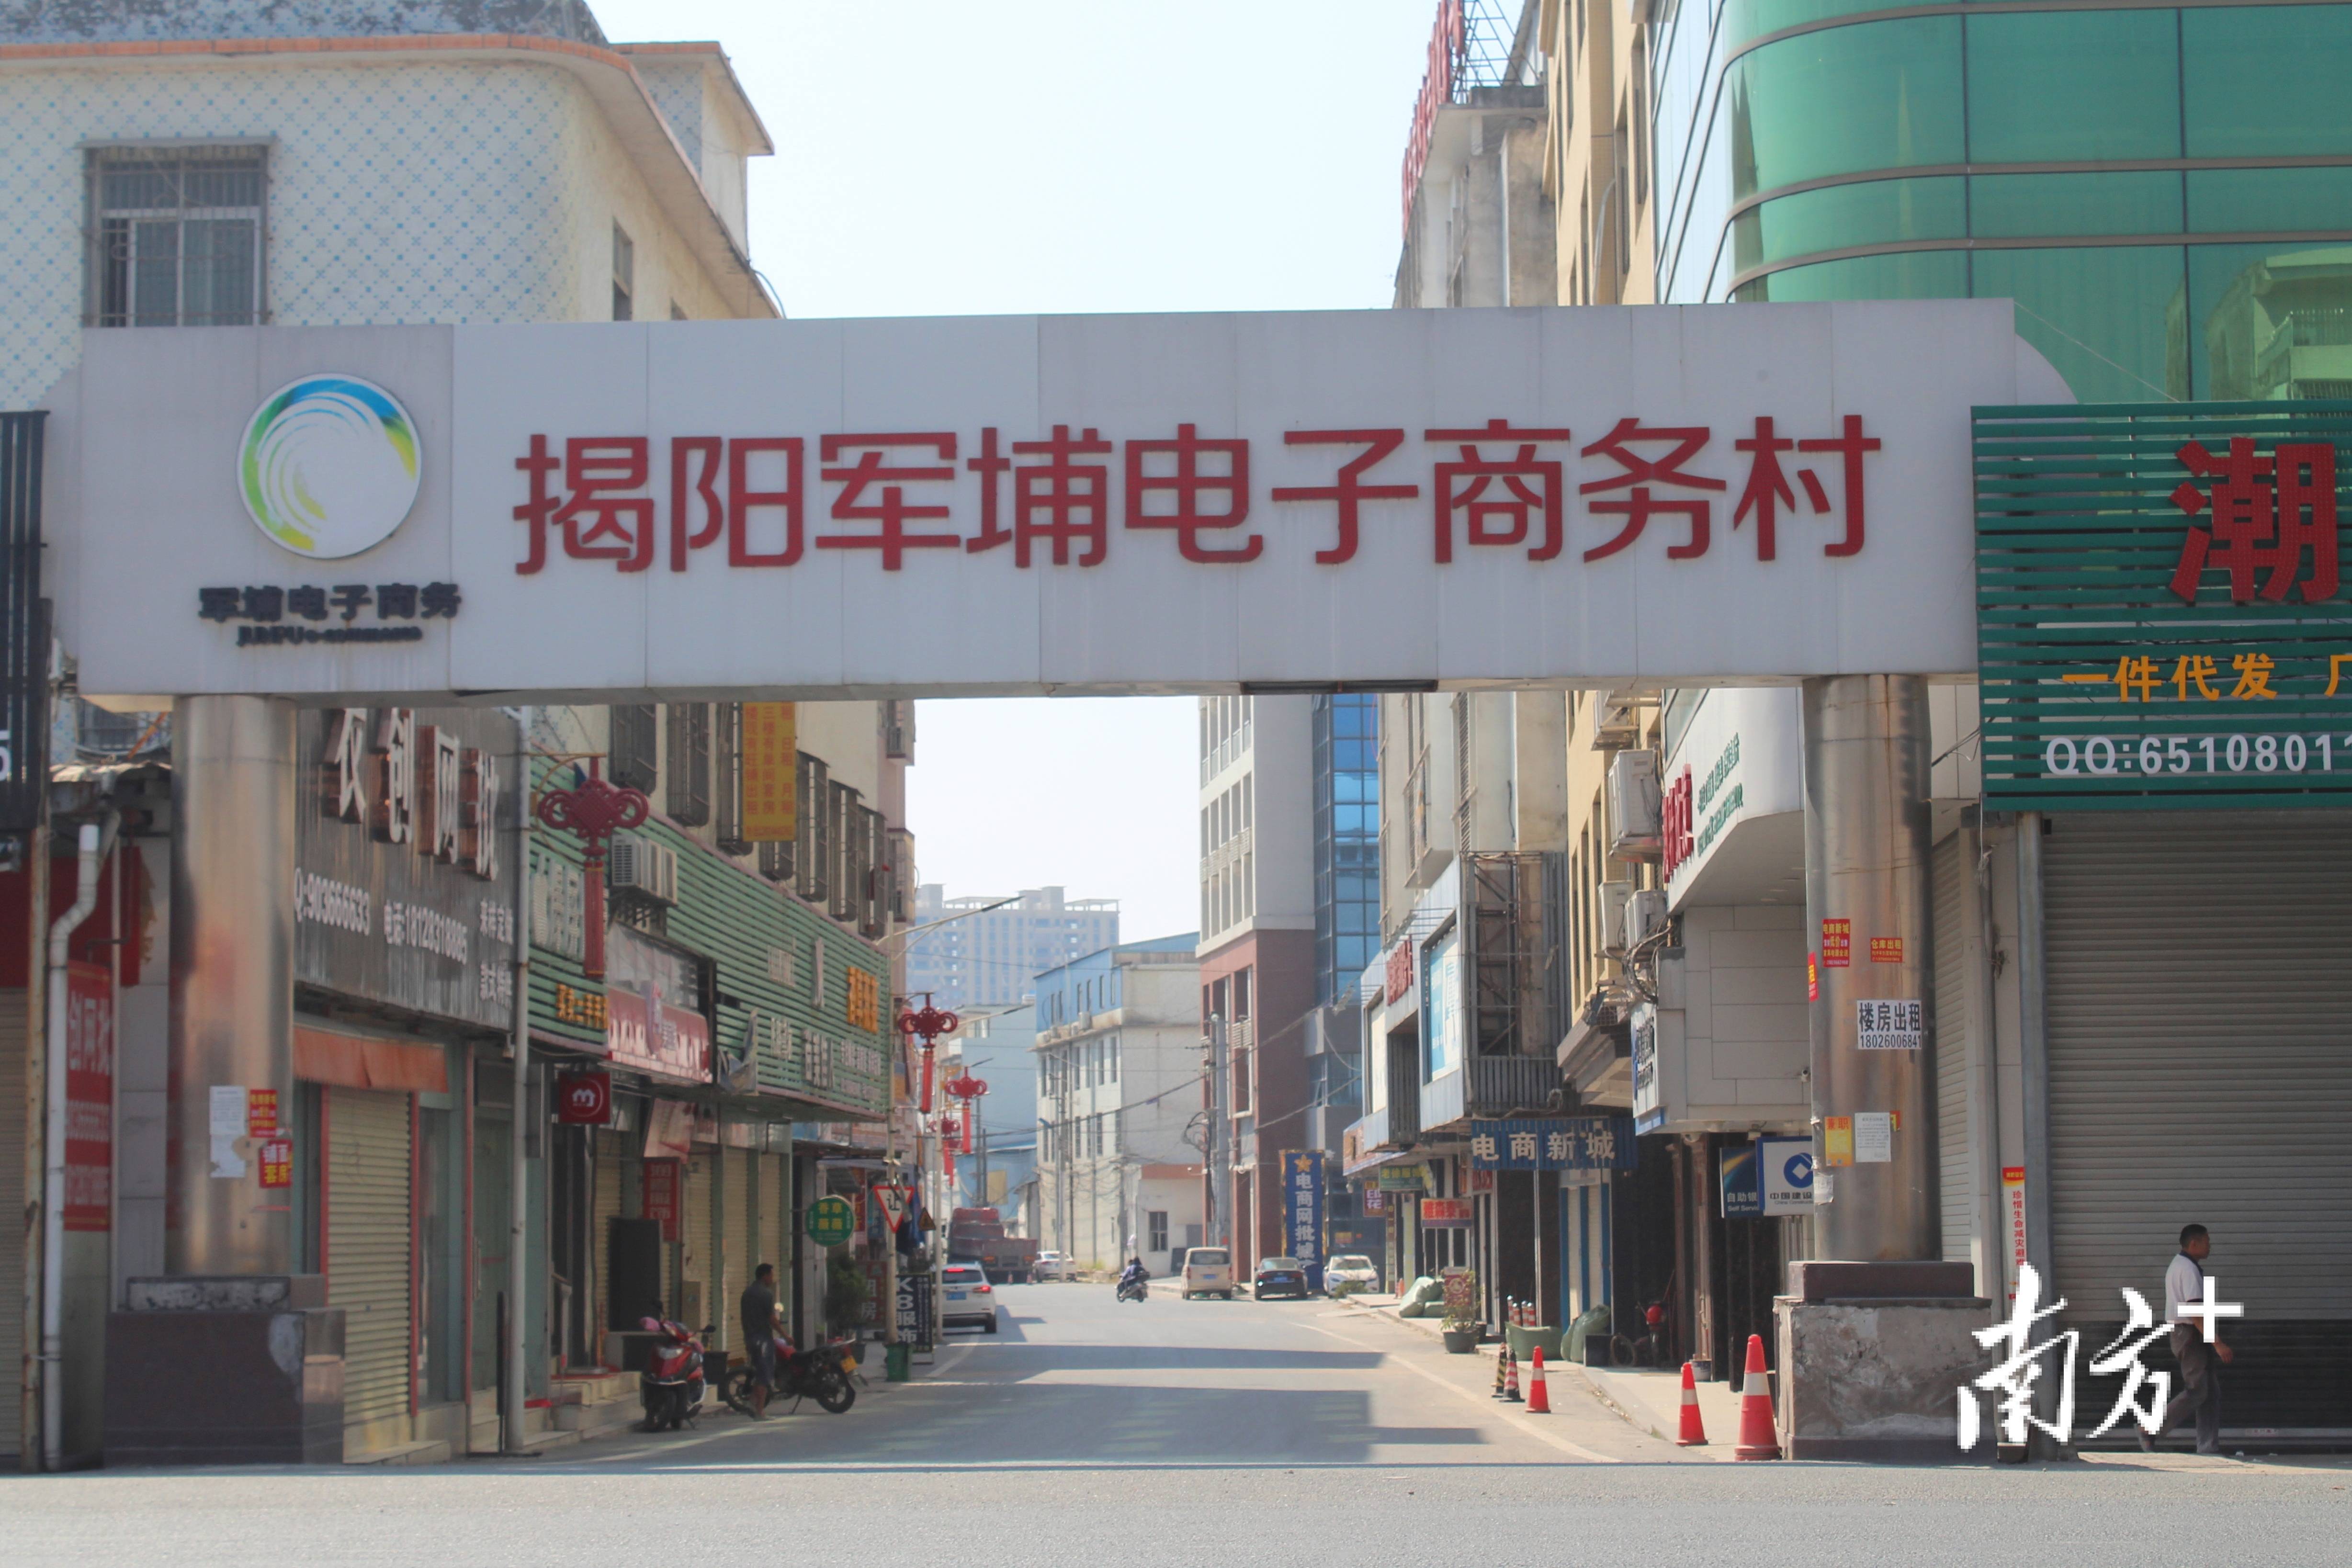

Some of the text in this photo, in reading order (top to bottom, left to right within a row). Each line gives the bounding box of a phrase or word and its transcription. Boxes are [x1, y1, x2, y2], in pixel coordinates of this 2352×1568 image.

[513, 415, 1881, 575] 揭阳军埔电子商务村
[2169, 437, 2340, 602] 潮
[2061, 652, 2278, 703] 一件代发
[1871, 939, 1901, 949] 仓库出租
[1859, 1002, 1921, 1032] 楼房出租
[1860, 1034, 1921, 1048] 18026006841
[1827, 1117, 1849, 1129] 兼职
[1471, 1131, 1616, 1161] 电商新城
[1770, 1192, 1812, 1200] 中国建设
[1295, 1173, 1315, 1259] 电商网批城
